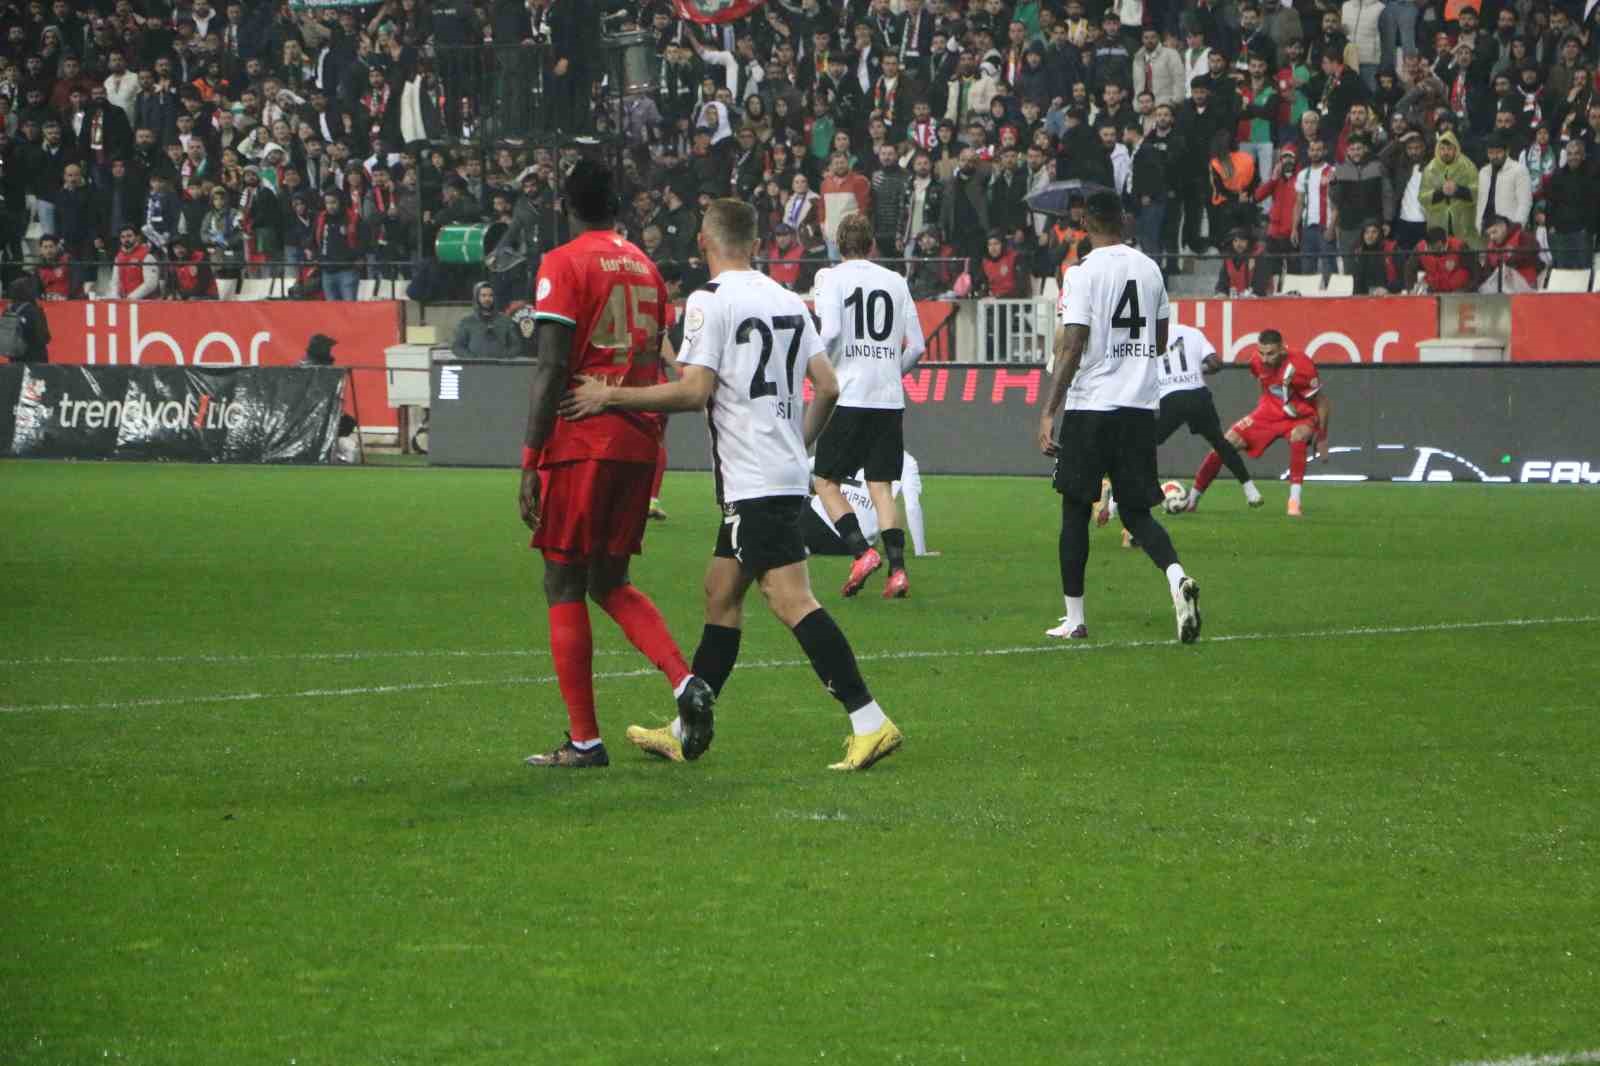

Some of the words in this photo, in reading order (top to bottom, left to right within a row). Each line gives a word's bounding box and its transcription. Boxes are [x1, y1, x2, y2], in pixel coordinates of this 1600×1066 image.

[592, 284, 658, 364] 45
[844, 287, 894, 341] 10
[1112, 280, 1147, 339] 4
[736, 315, 806, 400] 27
